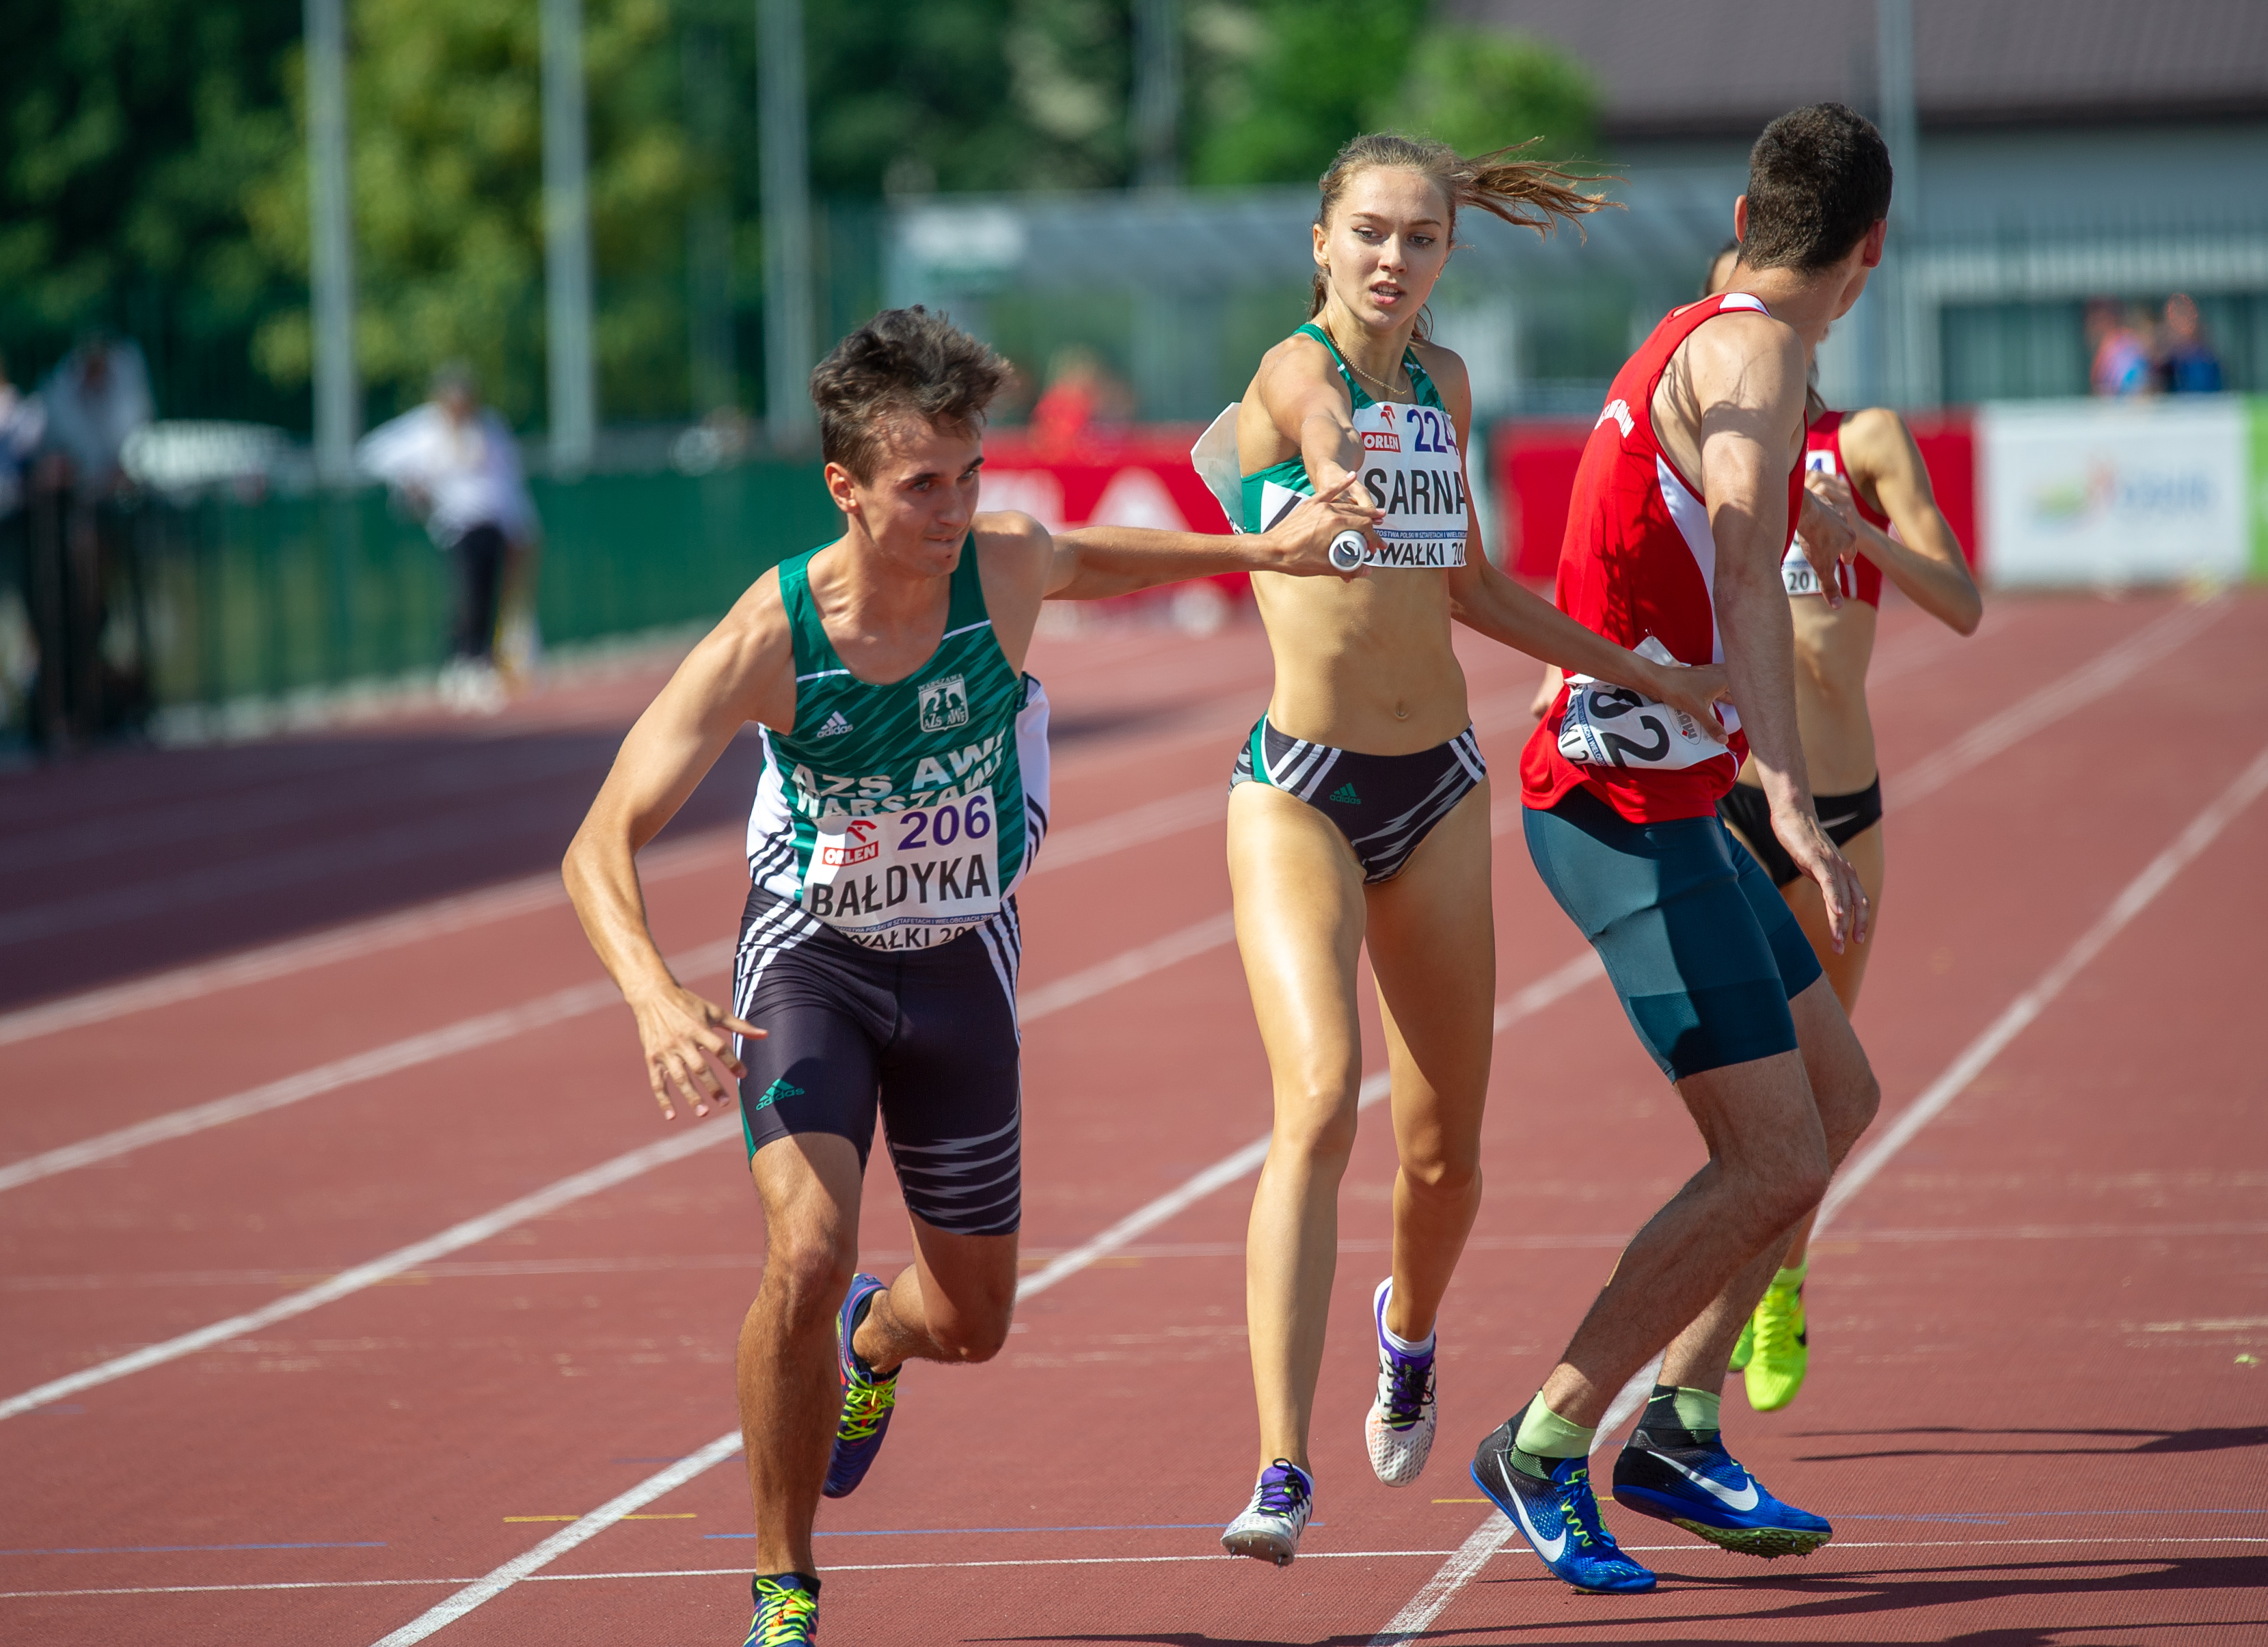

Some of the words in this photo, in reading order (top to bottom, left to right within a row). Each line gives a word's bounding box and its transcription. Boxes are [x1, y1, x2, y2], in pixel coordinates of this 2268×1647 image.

[1364, 434, 1400, 450] ORLEN
[1364, 467, 1466, 515] SARNA
[924, 712, 943, 729] AZS
[947, 707, 965, 725] AWF
[816, 723, 854, 739] adidas
[791, 763, 893, 798] AZS
[1329, 794, 1362, 804] adidas
[897, 795, 990, 851] 206
[824, 843, 876, 865] ORLEN
[809, 854, 992, 918] BAŁDYKA
[893, 918, 931, 926] SZTAFETACH
[935, 915, 980, 925] WIELOBOJACH
[755, 1088, 805, 1111] adidas
